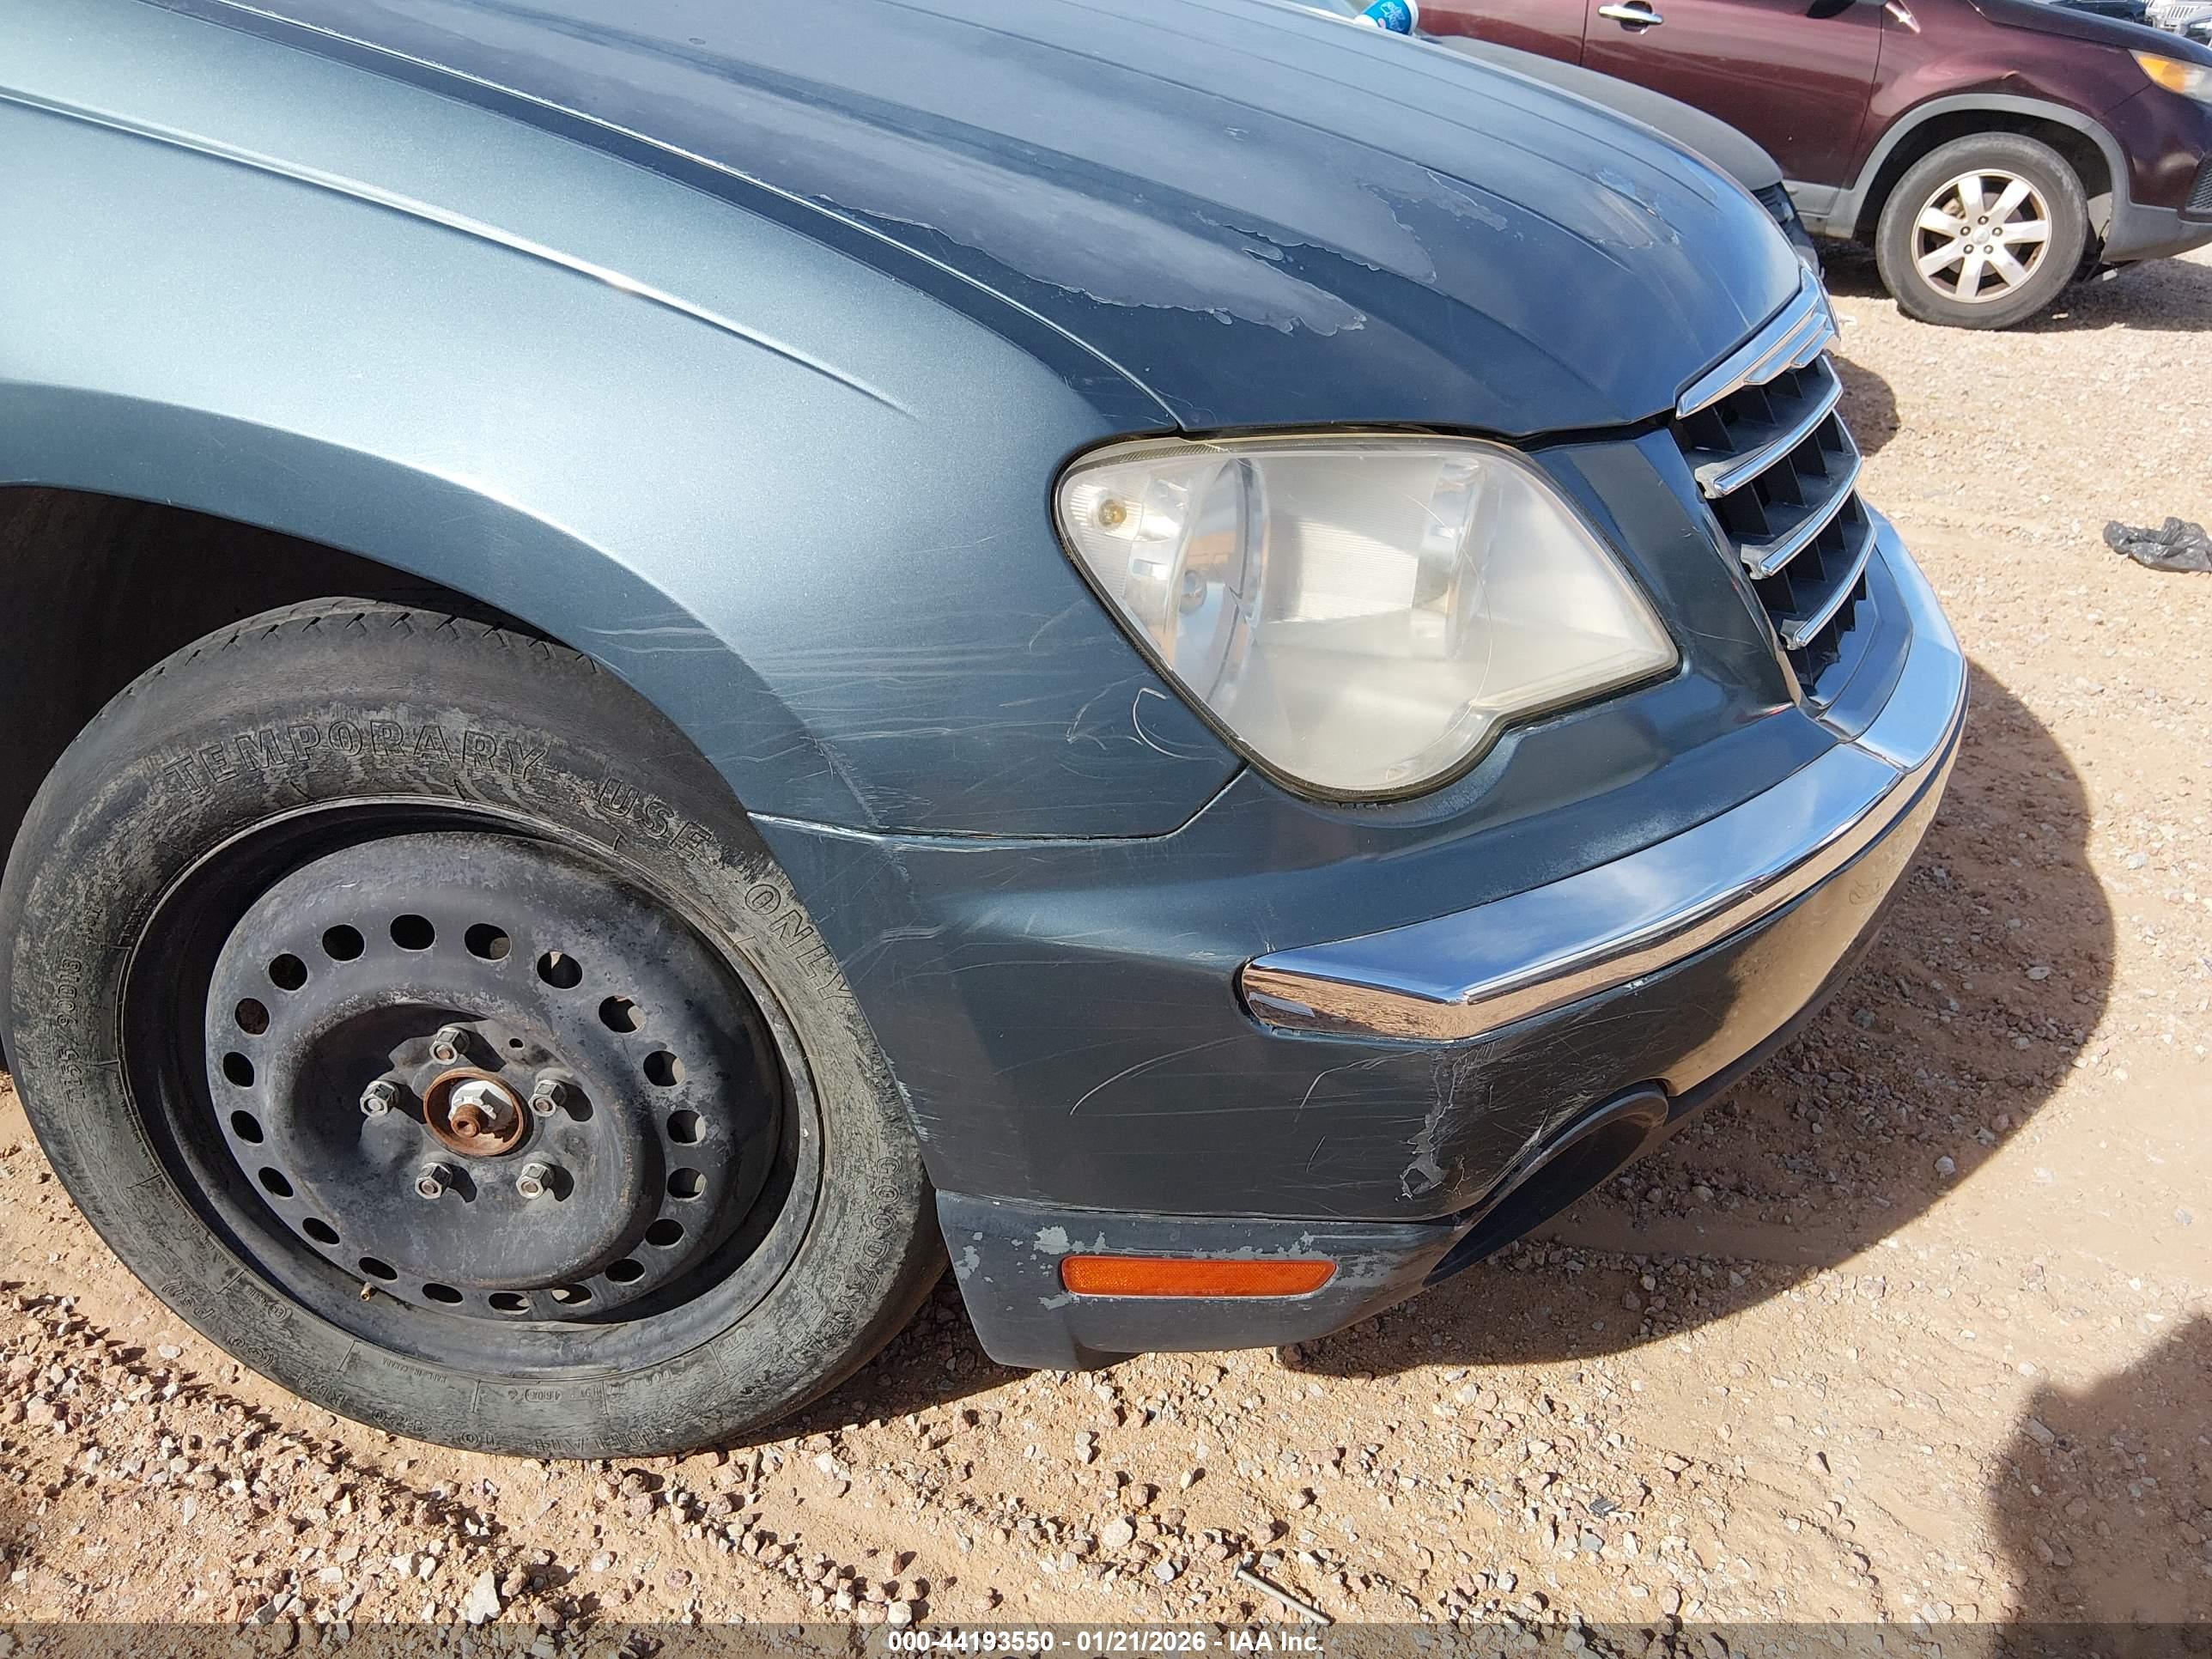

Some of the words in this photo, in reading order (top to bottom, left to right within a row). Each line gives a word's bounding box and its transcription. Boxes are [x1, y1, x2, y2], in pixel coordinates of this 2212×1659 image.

[165, 720, 547, 794] TEMPORARY
[599, 777, 713, 861] USE
[744, 883, 854, 1001] ONLY
